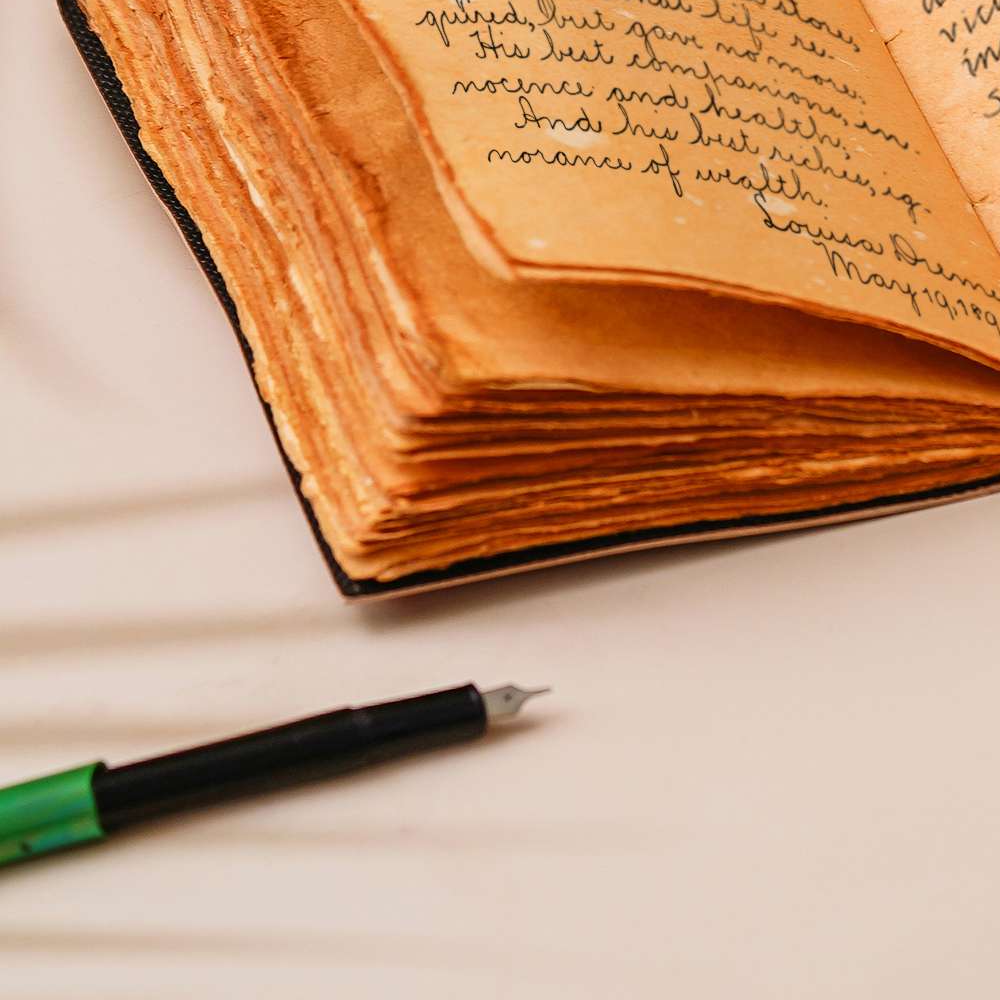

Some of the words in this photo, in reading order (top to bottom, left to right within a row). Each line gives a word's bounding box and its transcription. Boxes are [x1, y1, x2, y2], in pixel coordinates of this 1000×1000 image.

[416, 0, 536, 48] quired,
[624, 21, 703, 65] gave
[716, 40, 760, 61] no
[470, 25, 530, 60] His
[540, 29, 614, 65] best
[452, 77, 594, 98] nocence
[605, 84, 689, 109] and
[488, 149, 631, 171] norance
[641, 144, 684, 198] of
[696, 162, 829, 208] wealth.
[514, 95, 602, 132] And
[613, 102, 679, 140] his
[689, 112, 760, 155] best
[769, 145, 876, 197] riches,
[753, 191, 884, 255] Louisa
[813, 240, 922, 317] May
